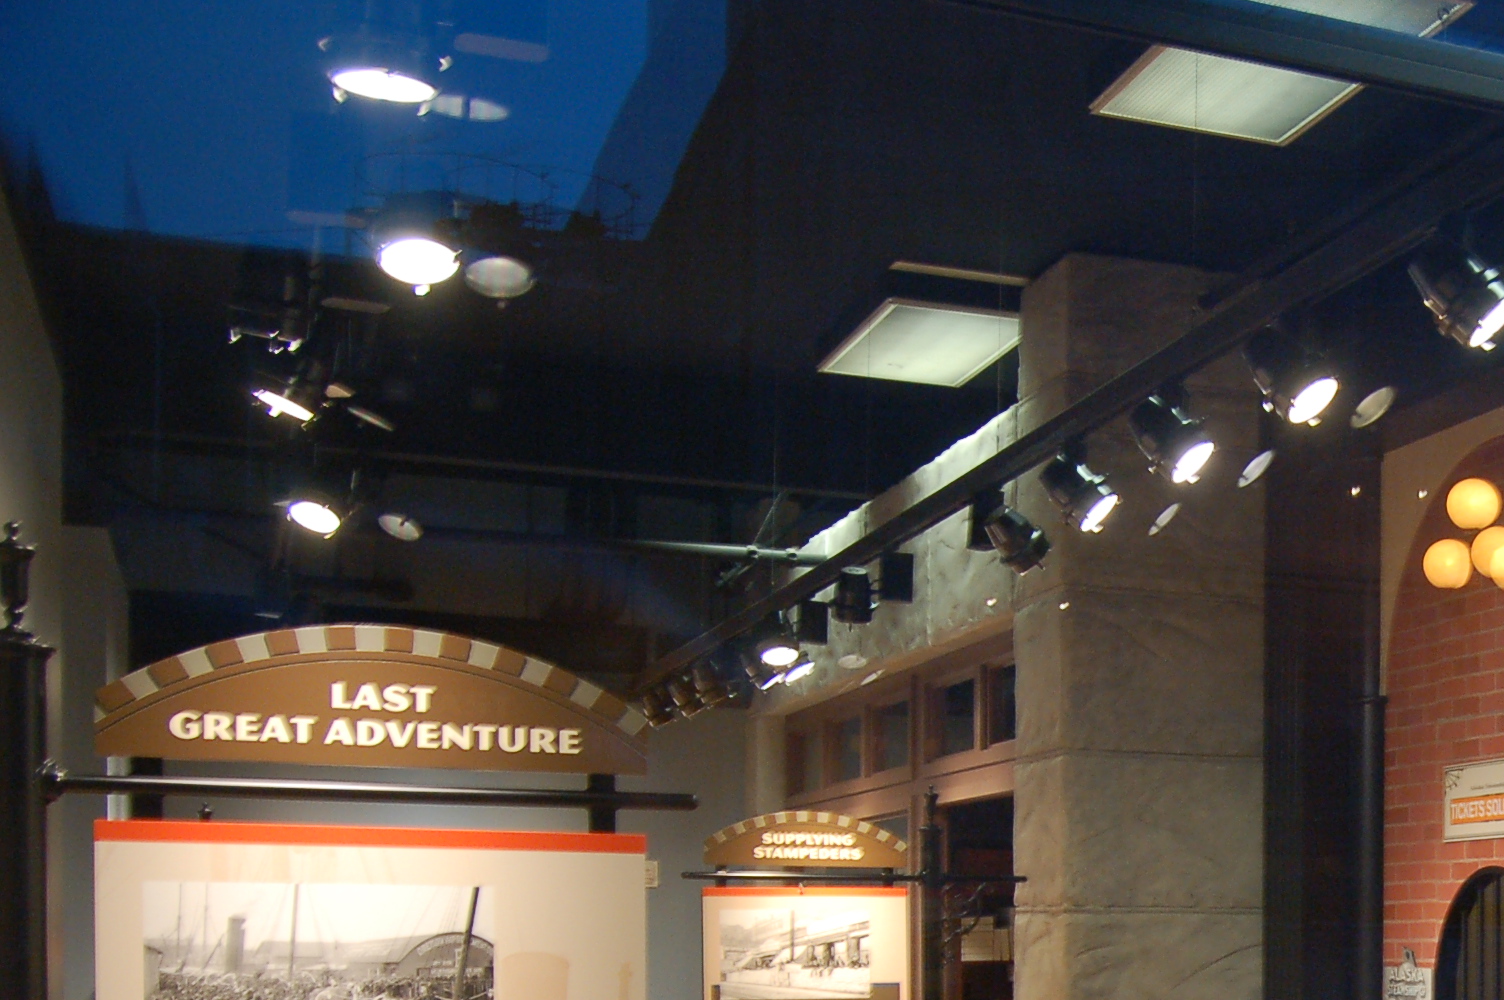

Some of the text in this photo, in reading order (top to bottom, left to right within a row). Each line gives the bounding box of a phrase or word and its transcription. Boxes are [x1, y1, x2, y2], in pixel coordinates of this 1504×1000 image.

[331, 681, 436, 713] LAST
[169, 710, 582, 755] GREAT ADVENTURE
[1451, 800, 1485, 820] TICKETS
[761, 830, 857, 847] SUPPLYING
[753, 844, 864, 861] STAMPEDERS
[1389, 968, 1425, 982] ALASKA
